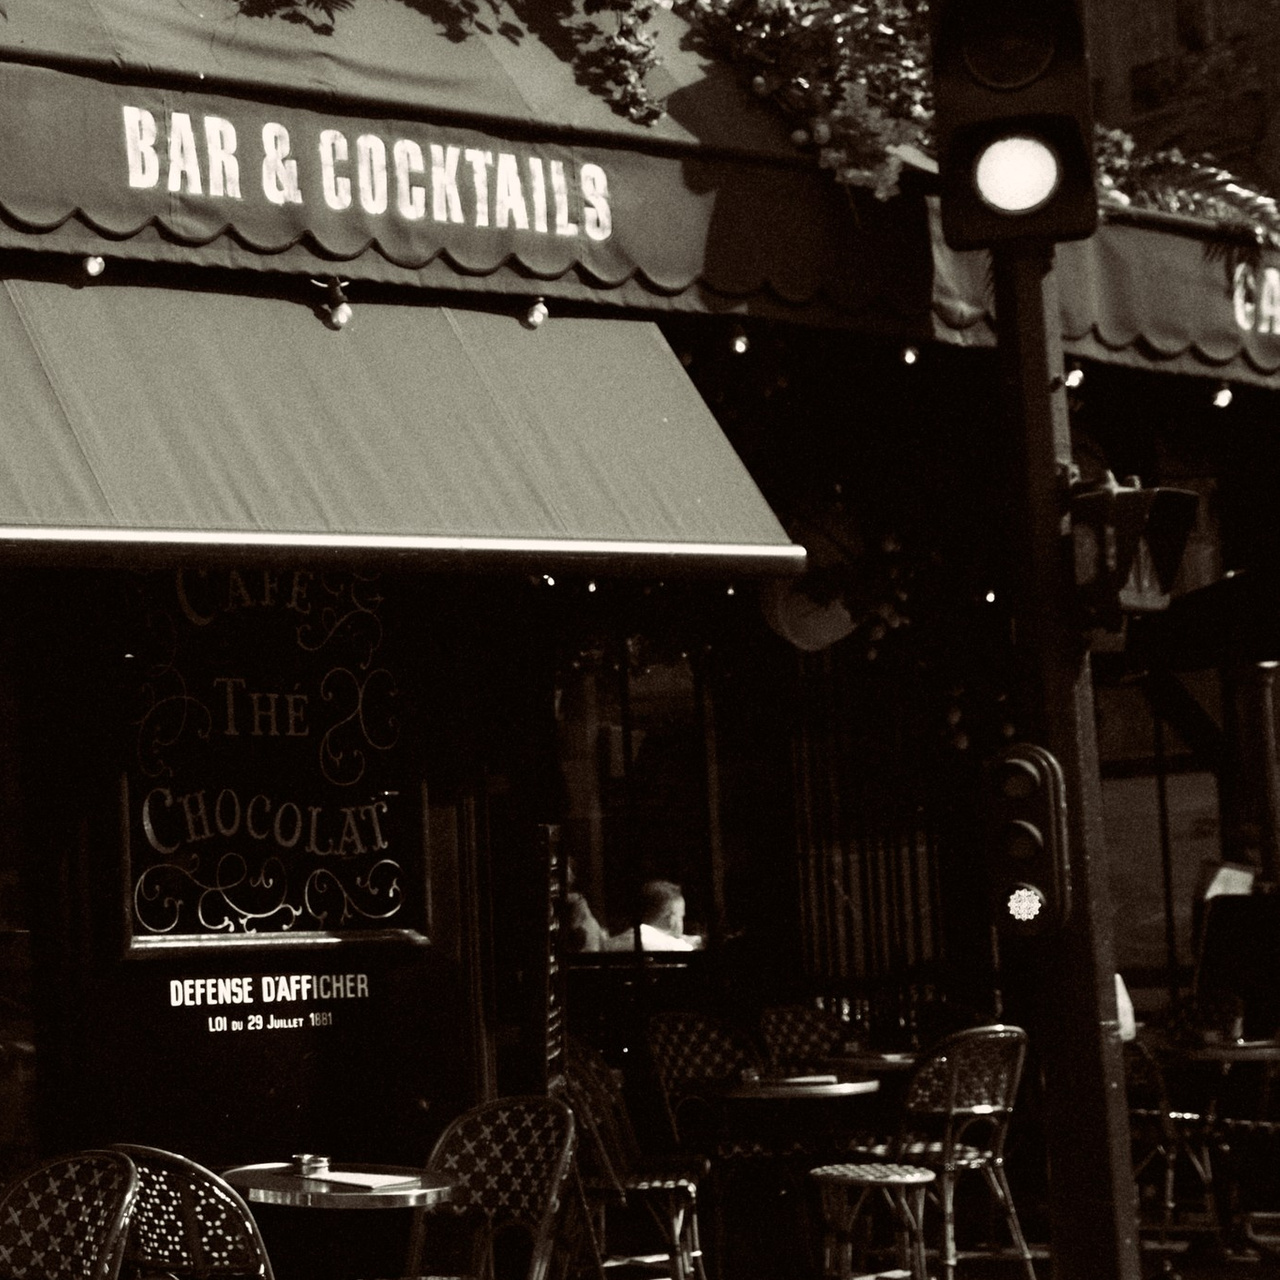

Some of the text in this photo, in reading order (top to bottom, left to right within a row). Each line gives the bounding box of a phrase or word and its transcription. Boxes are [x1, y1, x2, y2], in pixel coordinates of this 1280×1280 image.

[123, 105, 613, 241] BAR & COCKTAILS
[213, 677, 310, 737] THÉ
[142, 787, 388, 857] CHOCOLAT
[170, 974, 369, 1007] DEFENSE D'AFFICHER
[208, 1016, 227, 1032] LOI
[247, 1015, 263, 1030] 29
[309, 1012, 333, 1027] 1881
